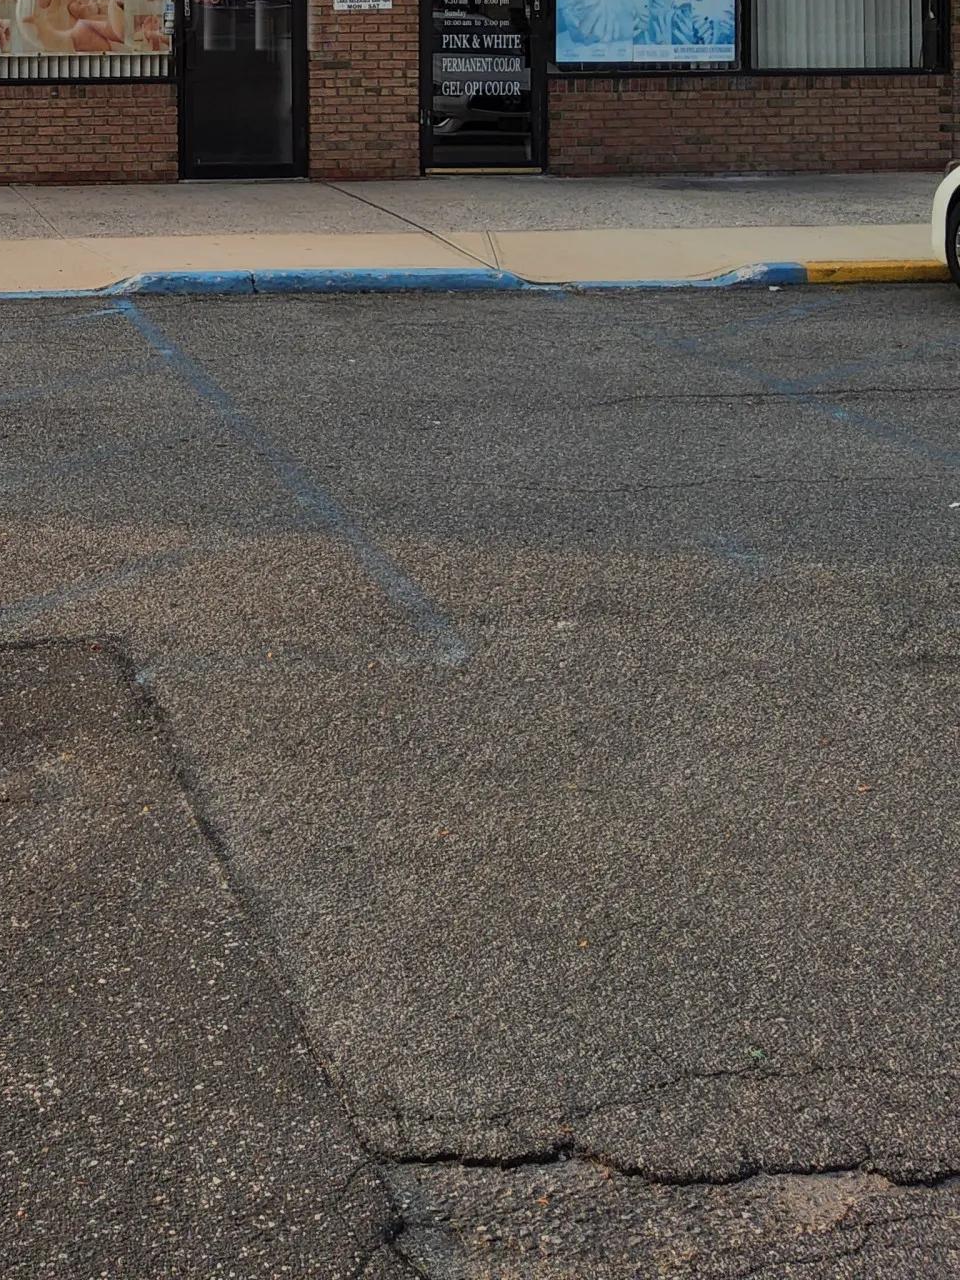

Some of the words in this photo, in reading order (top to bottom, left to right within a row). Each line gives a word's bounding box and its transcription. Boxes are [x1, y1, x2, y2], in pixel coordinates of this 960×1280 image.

[444, 9, 467, 18] Sunday
[499, 20, 510, 28] pm
[442, 34, 470, 49] PINK
[472, 34, 481, 49] &
[483, 34, 522, 49] WHITE
[441, 57, 492, 72] PERMANENT
[493, 57, 522, 72] COLOR
[441, 81, 464, 96] GEL
[465, 81, 483, 97] OPI
[485, 81, 521, 96] COLOR
